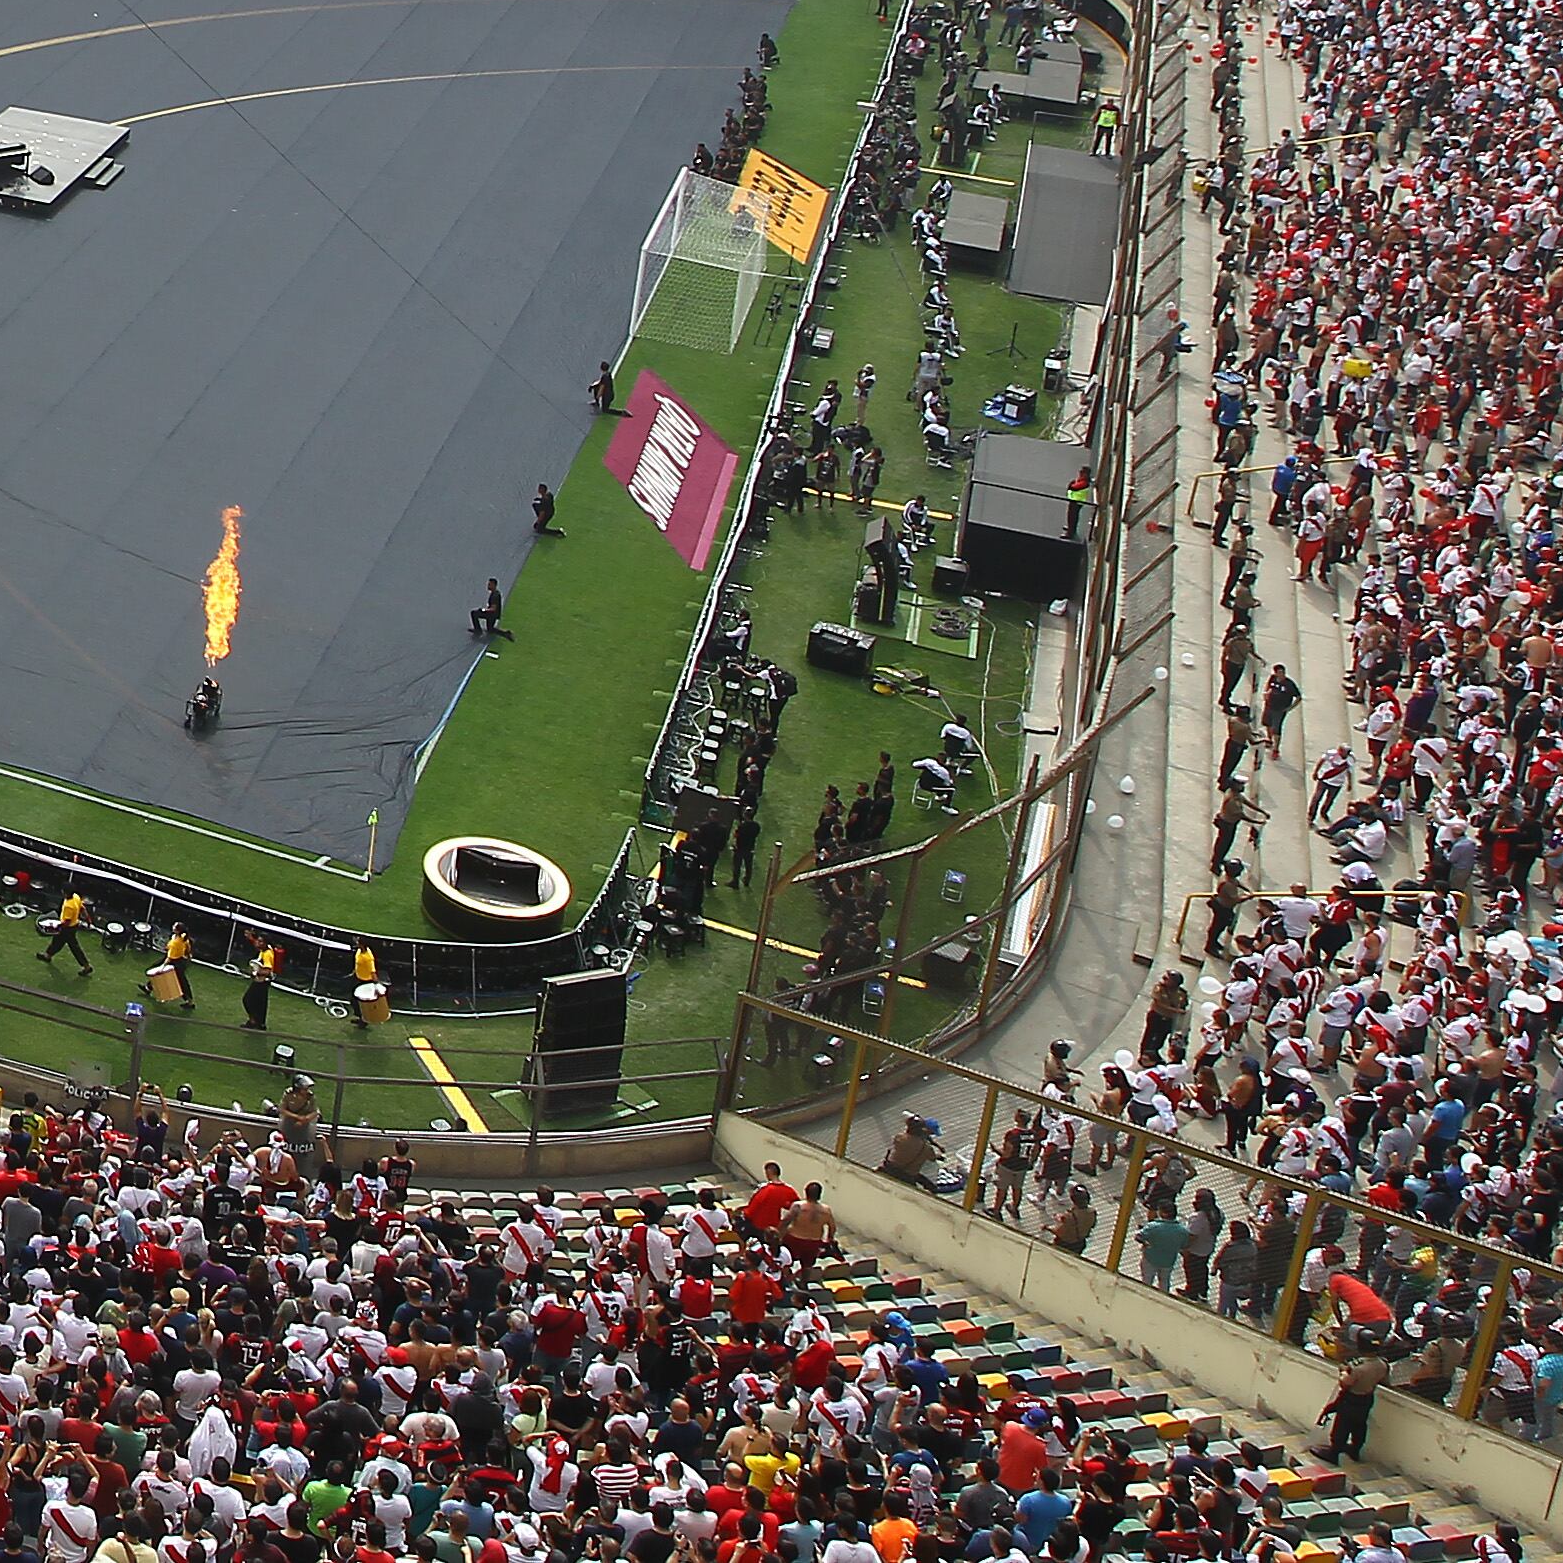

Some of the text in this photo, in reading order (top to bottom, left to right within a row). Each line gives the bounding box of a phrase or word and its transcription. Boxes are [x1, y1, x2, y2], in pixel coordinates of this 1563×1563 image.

[626, 392, 702, 531] QATAR AIRWAYS
[282, 1141, 315, 1154] OLICIA
[241, 1347, 261, 1364] 14
